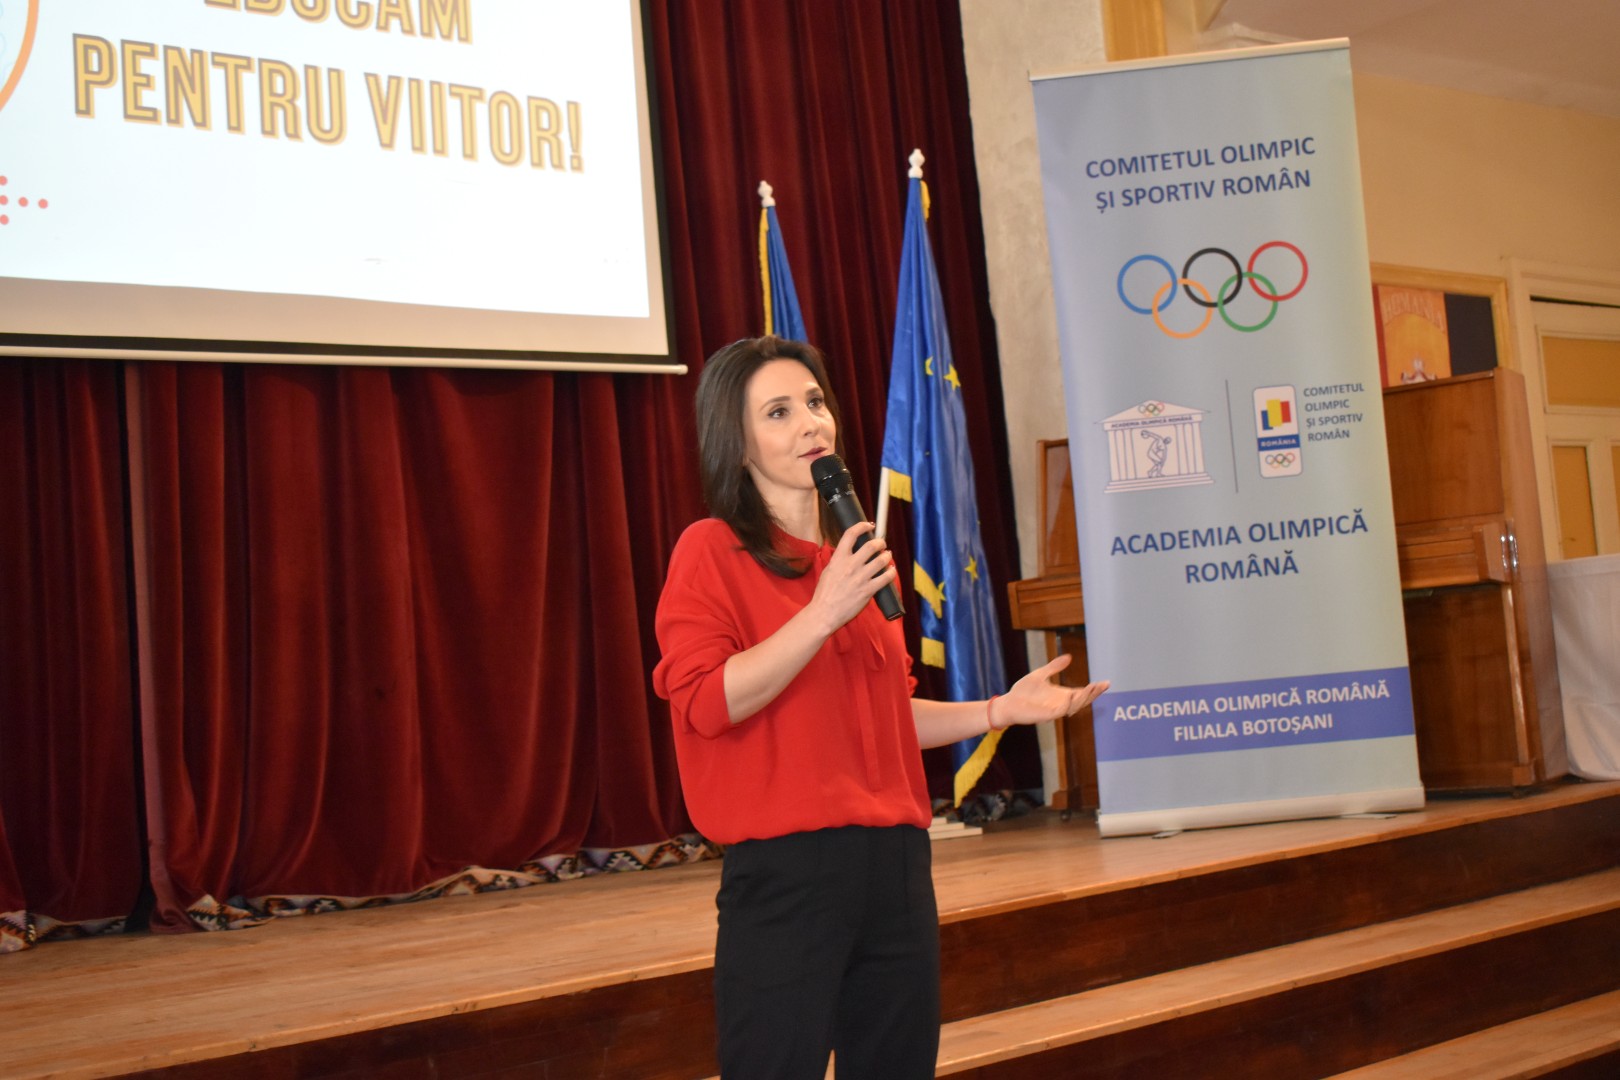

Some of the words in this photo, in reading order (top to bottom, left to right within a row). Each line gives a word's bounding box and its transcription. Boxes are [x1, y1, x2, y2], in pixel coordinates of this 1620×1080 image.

[72, 33, 346, 145] PENTRU
[363, 72, 584, 173] VIITOR!
[1086, 149, 1215, 179] COMITETUL
[1222, 137, 1316, 164] OLIMPIC
[1121, 180, 1215, 207] SPORTIV
[1222, 168, 1311, 197] ROMÂN
[1304, 383, 1364, 397] COMITETUL
[1305, 399, 1350, 412] OLIMPIC
[1307, 428, 1350, 442] ROMÂN
[1318, 413, 1363, 426] SPORTIV
[1110, 526, 1242, 556] ACADEMIA
[1248, 508, 1369, 543] OLIMPICĂ
[1185, 549, 1299, 584] ROMÂNĂ
[1113, 698, 1210, 722] ACADEMIA
[1214, 687, 1302, 713] OLIMPICĂ
[1306, 679, 1390, 704] ROMÂNĂ
[1173, 721, 1238, 742] FILIALA
